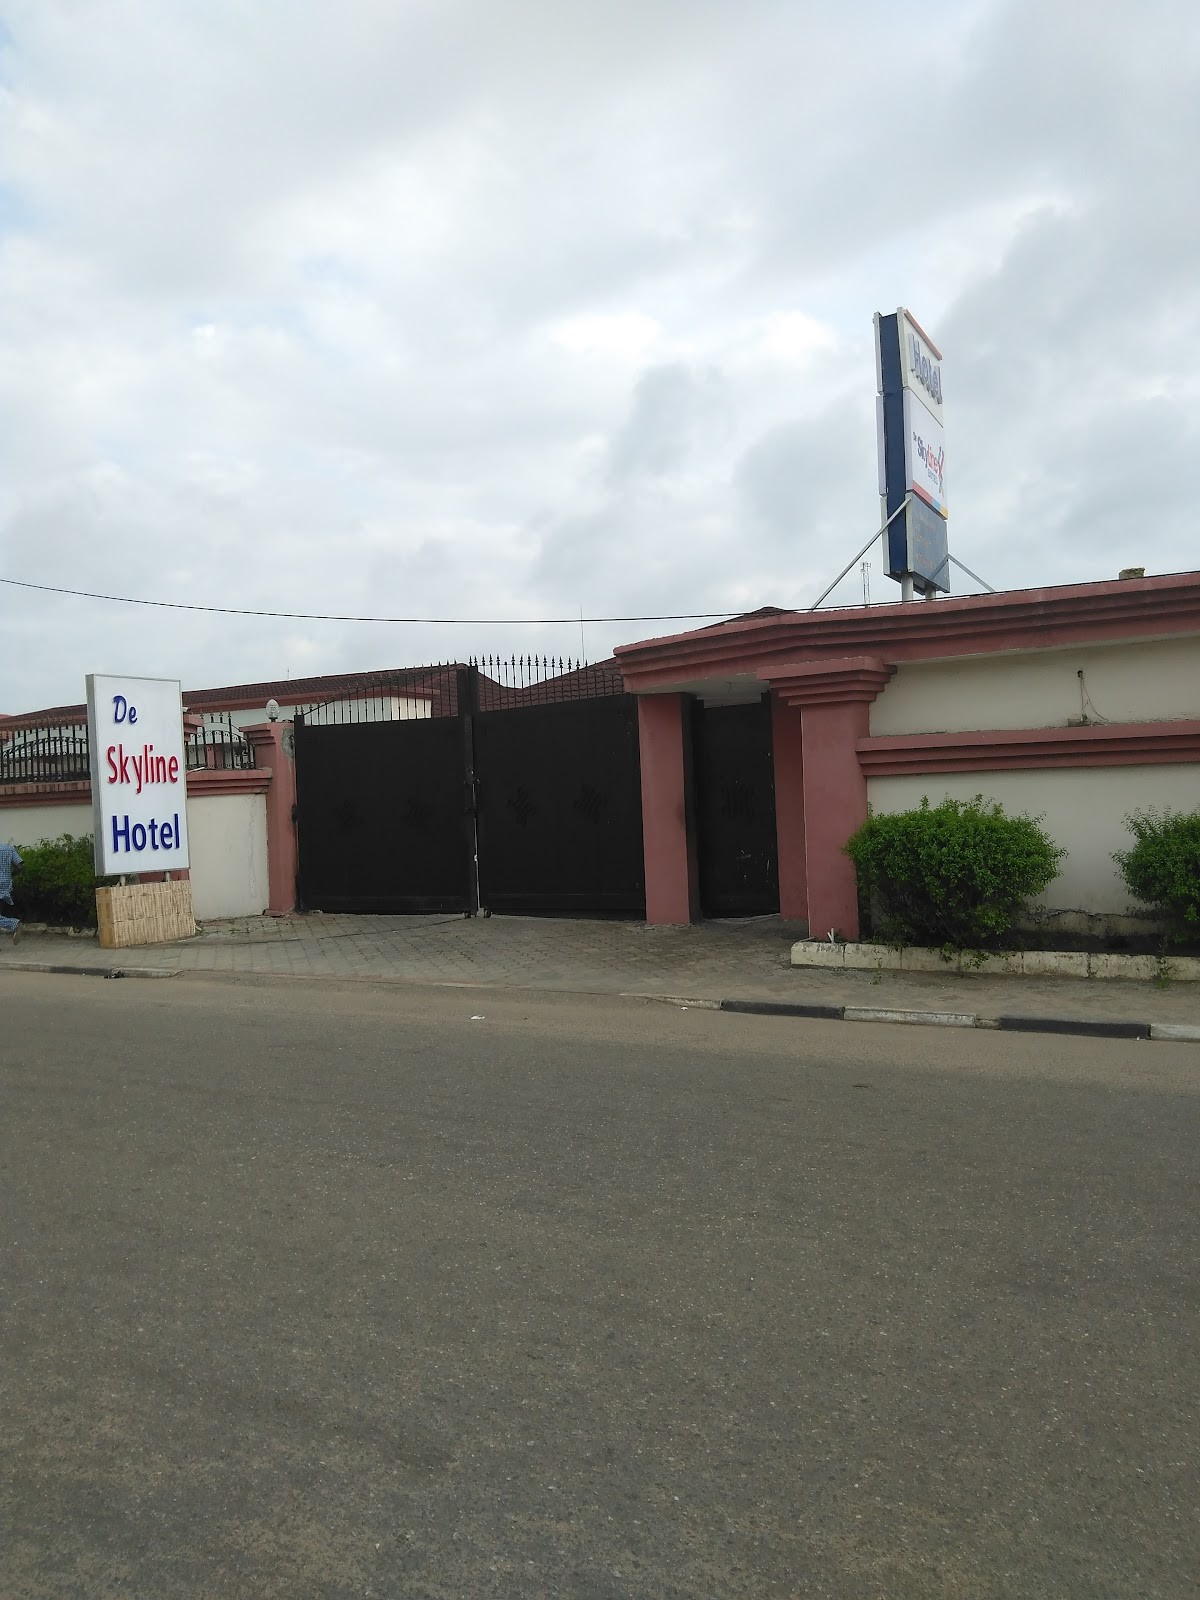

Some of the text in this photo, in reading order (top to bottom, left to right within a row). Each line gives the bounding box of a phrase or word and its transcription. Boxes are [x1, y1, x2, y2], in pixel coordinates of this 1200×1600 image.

[909, 333, 943, 405] Hotel
[112, 695, 138, 724] De
[107, 744, 179, 795] Skyline
[112, 813, 180, 853] Hotel
